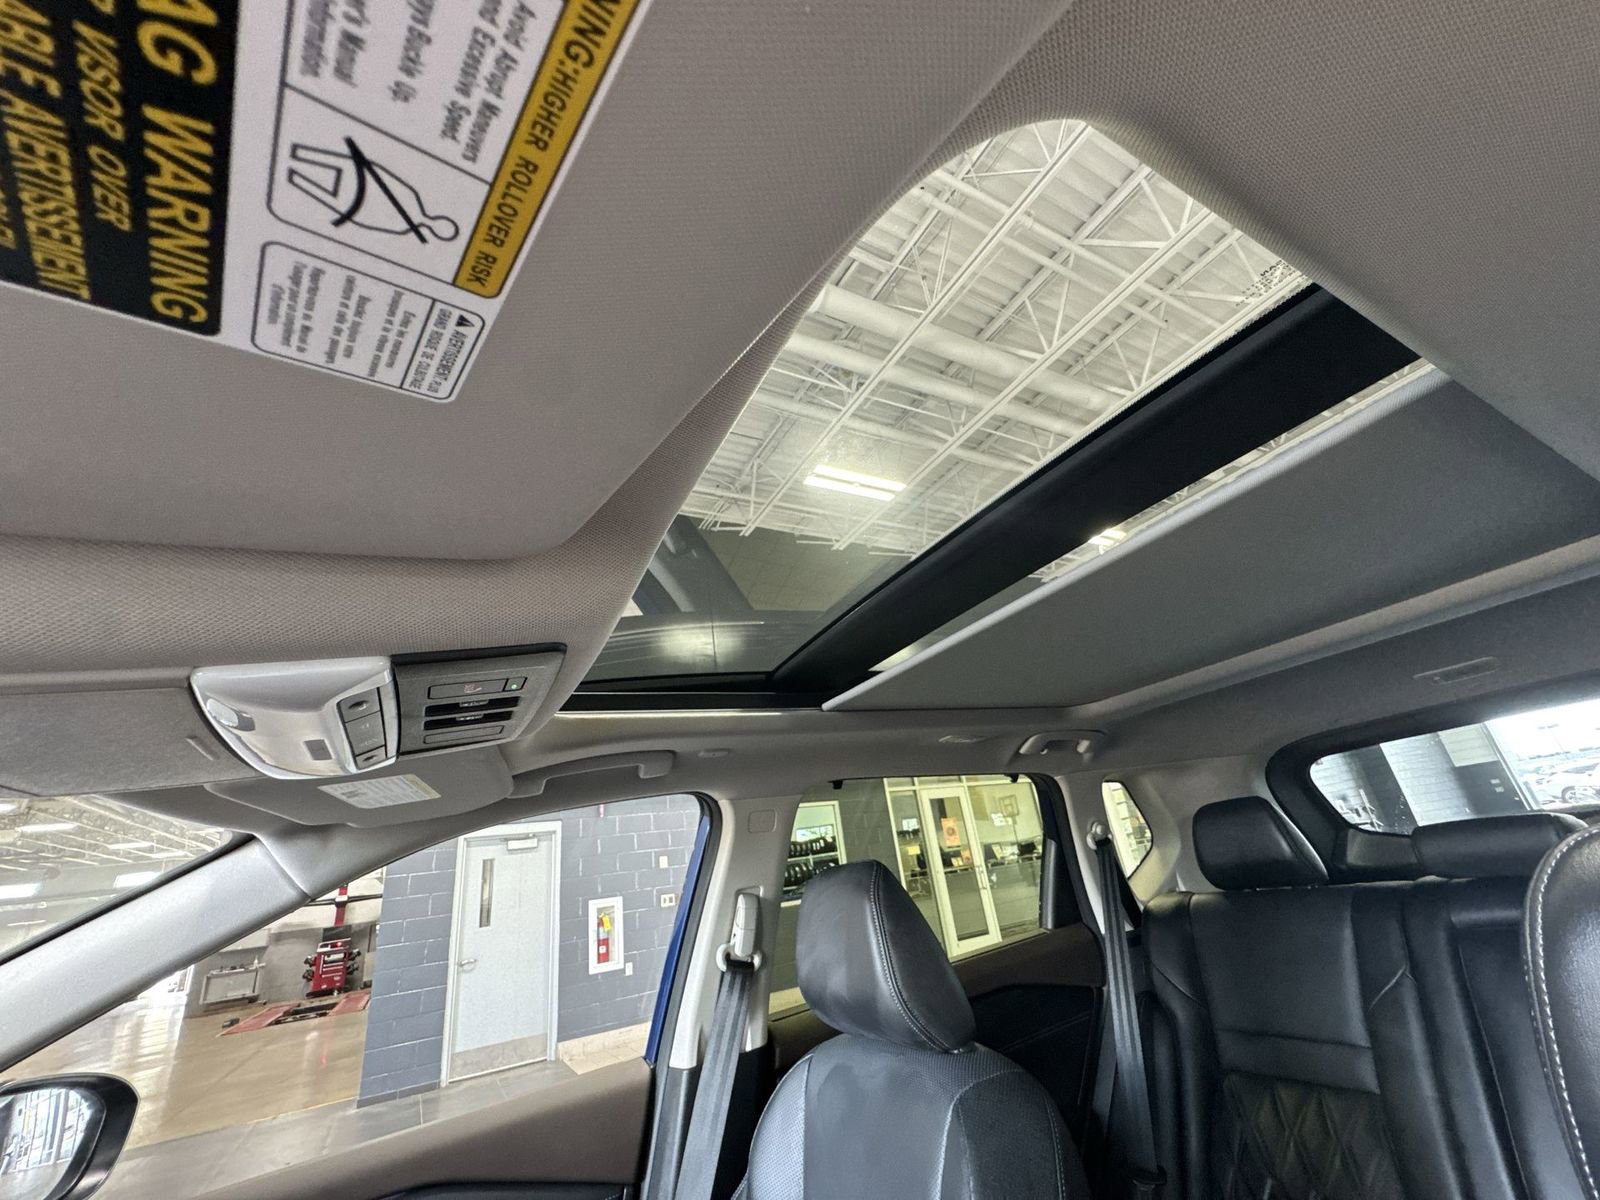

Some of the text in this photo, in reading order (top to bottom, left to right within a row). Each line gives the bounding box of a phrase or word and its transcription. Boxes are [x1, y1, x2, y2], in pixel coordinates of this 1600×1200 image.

[72, 19, 125, 141] VISOR
[524, 66, 580, 152] HIGHER
[0, 89, 90, 300] AVERTISSEMENT
[87, 145, 132, 232] OVER
[142, 104, 214, 323] WARNING
[483, 156, 539, 249] ROLLOVER
[466, 251, 498, 288] RISK
